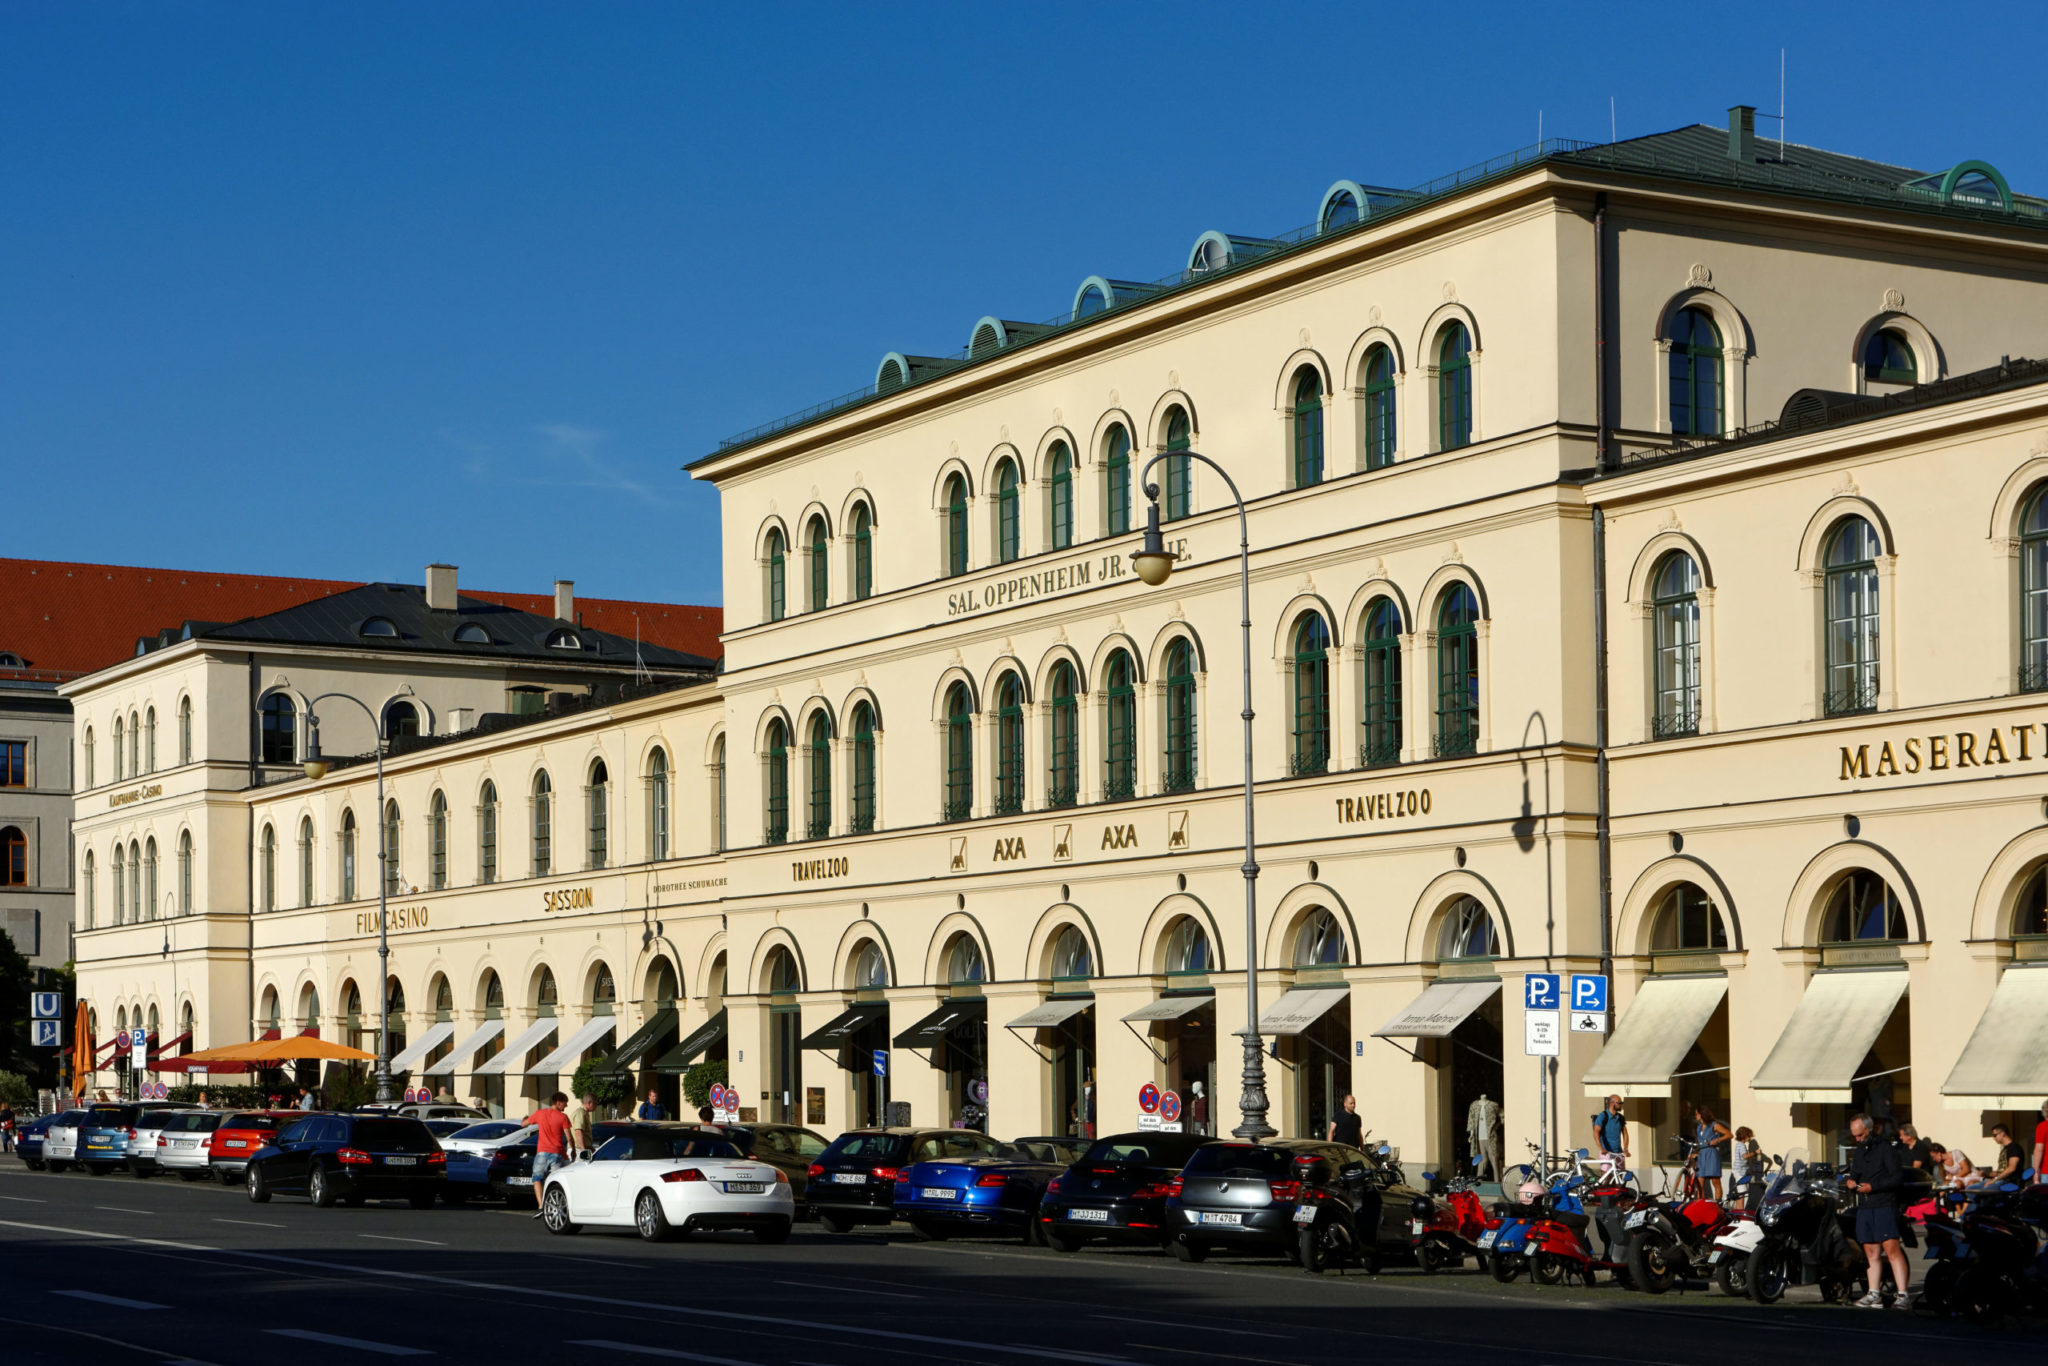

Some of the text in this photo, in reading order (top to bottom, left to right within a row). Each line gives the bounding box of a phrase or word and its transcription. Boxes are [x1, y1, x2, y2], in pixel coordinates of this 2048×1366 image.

[948, 589, 981, 616] SAL.
[984, 560, 1091, 607] OPPENHEIM
[1098, 554, 1126, 581] JR.
[1336, 788, 1433, 824] TRAVELZOO
[993, 836, 1027, 862] AXA
[1101, 823, 1138, 850] AXA
[792, 856, 849, 882] TRAVELZOO
[543, 887, 594, 912] SASSOON
[653, 882, 687, 894] DOROTHEE
[1530, 977, 1550, 1005] P
[1576, 979, 1596, 1006] P
[38, 994, 58, 1015] U
[134, 1031, 142, 1044] P
